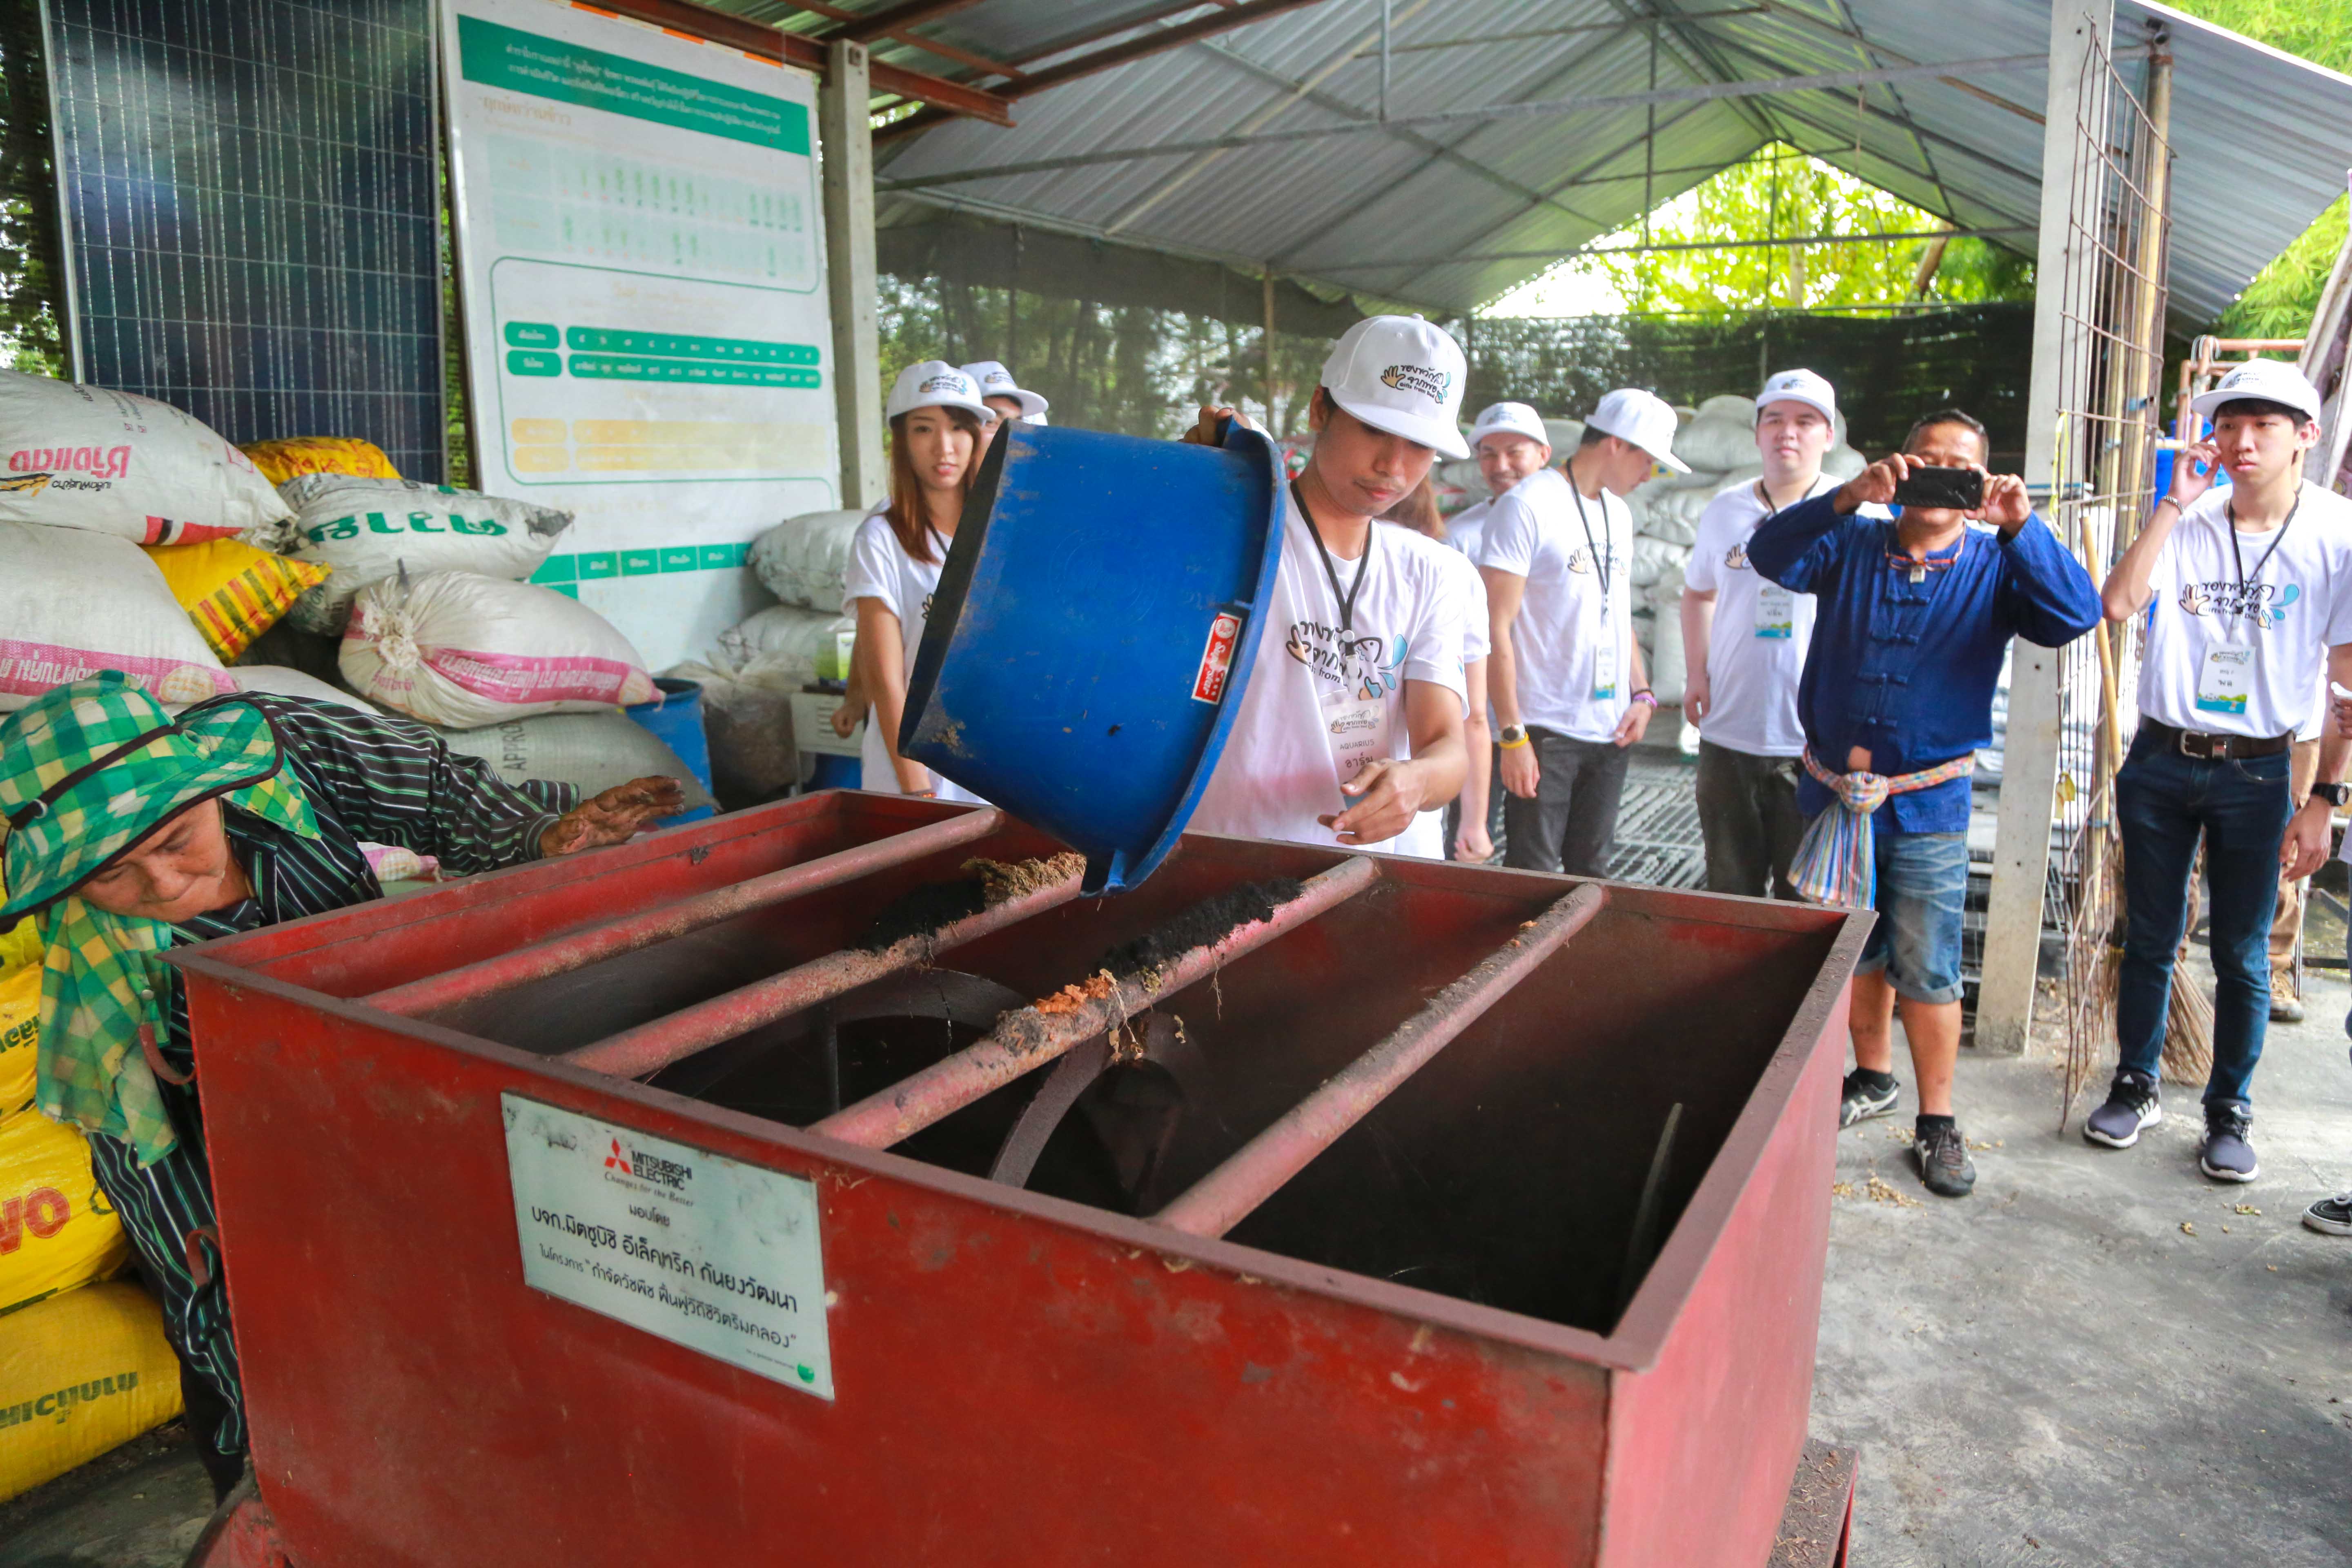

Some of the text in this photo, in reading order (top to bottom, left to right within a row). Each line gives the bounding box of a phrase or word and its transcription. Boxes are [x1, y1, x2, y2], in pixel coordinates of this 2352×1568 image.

[8, 444, 132, 479] ช้างแดง
[1340, 739, 1374, 751] AQUARIUS
[631, 1150, 693, 1180] MITSUBISHI
[633, 1164, 685, 1190] ELECTRIC
[629, 1204, 670, 1227] มอบโดย
